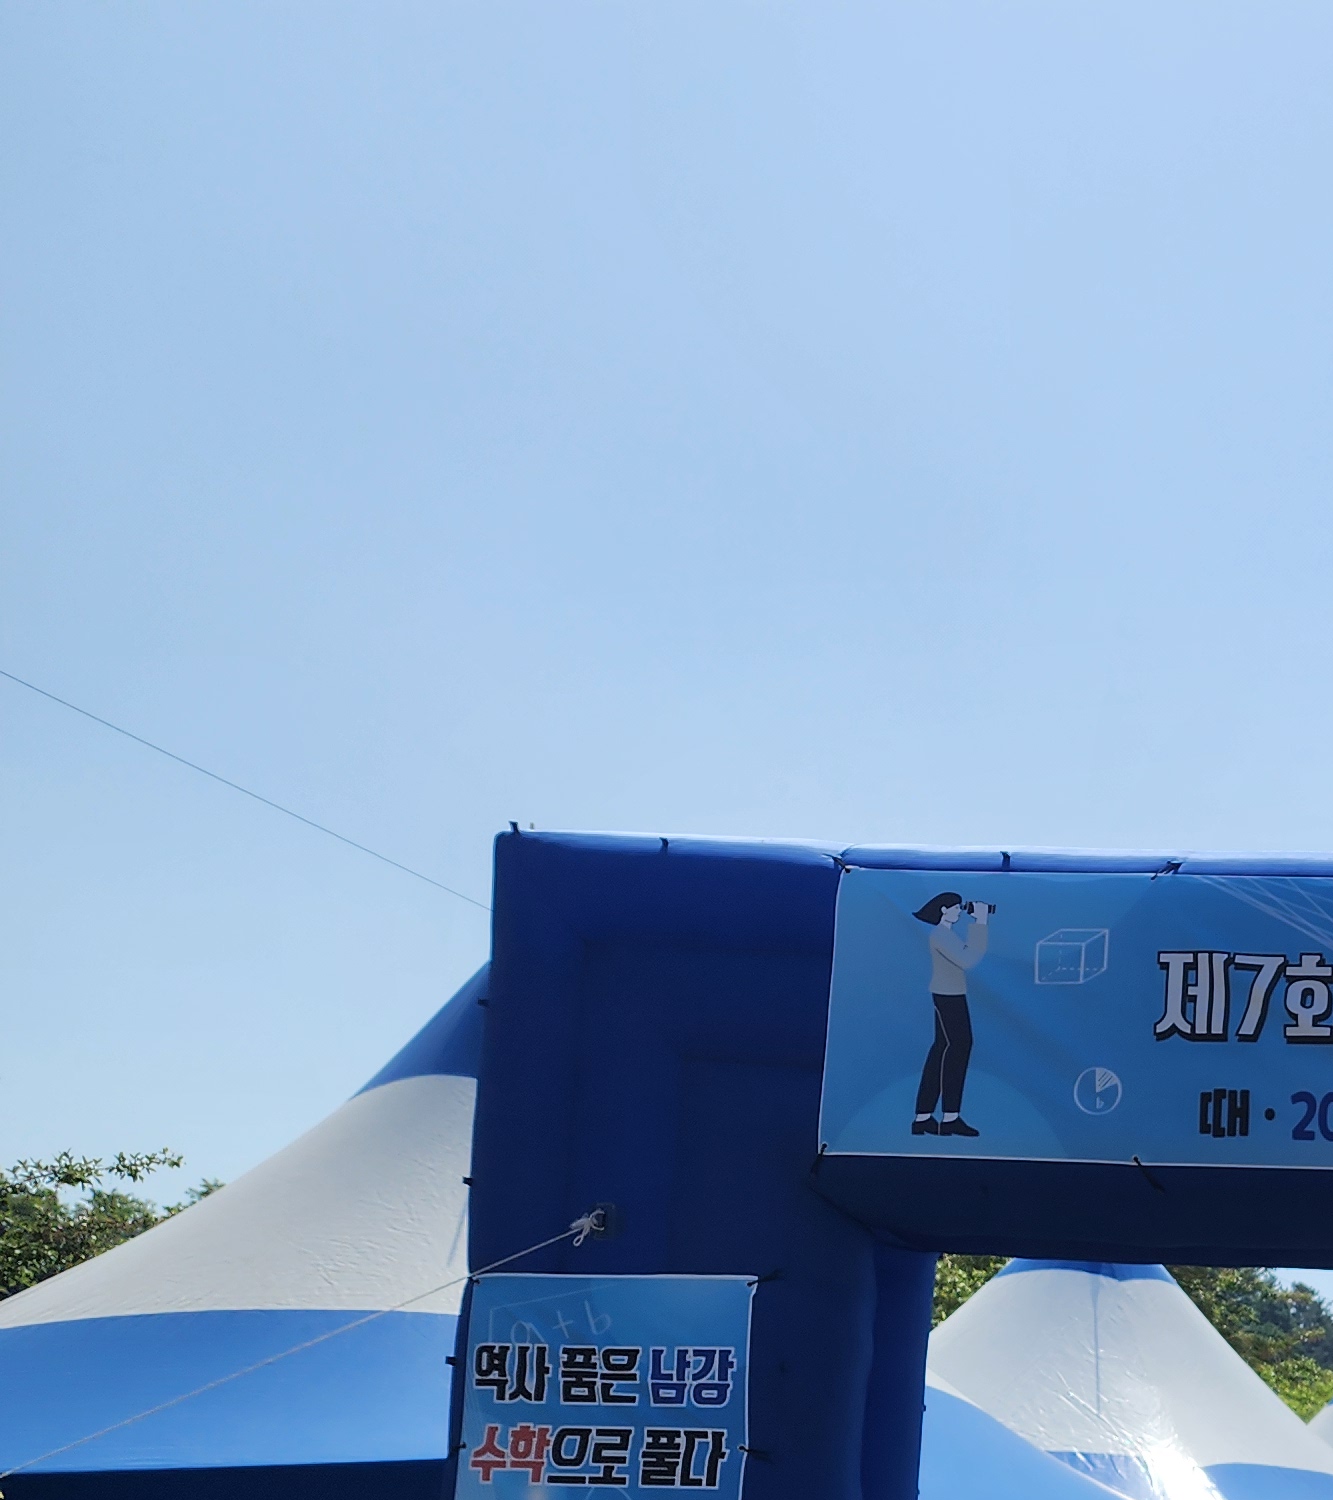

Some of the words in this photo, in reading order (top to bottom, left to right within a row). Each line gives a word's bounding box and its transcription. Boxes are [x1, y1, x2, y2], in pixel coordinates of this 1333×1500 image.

[472, 1344, 551, 1403] 역사
[560, 1345, 642, 1405] 품은
[649, 1346, 737, 1408] 남강
[469, 1423, 634, 1487] 수학으로
[639, 1427, 728, 1489] 풀다
